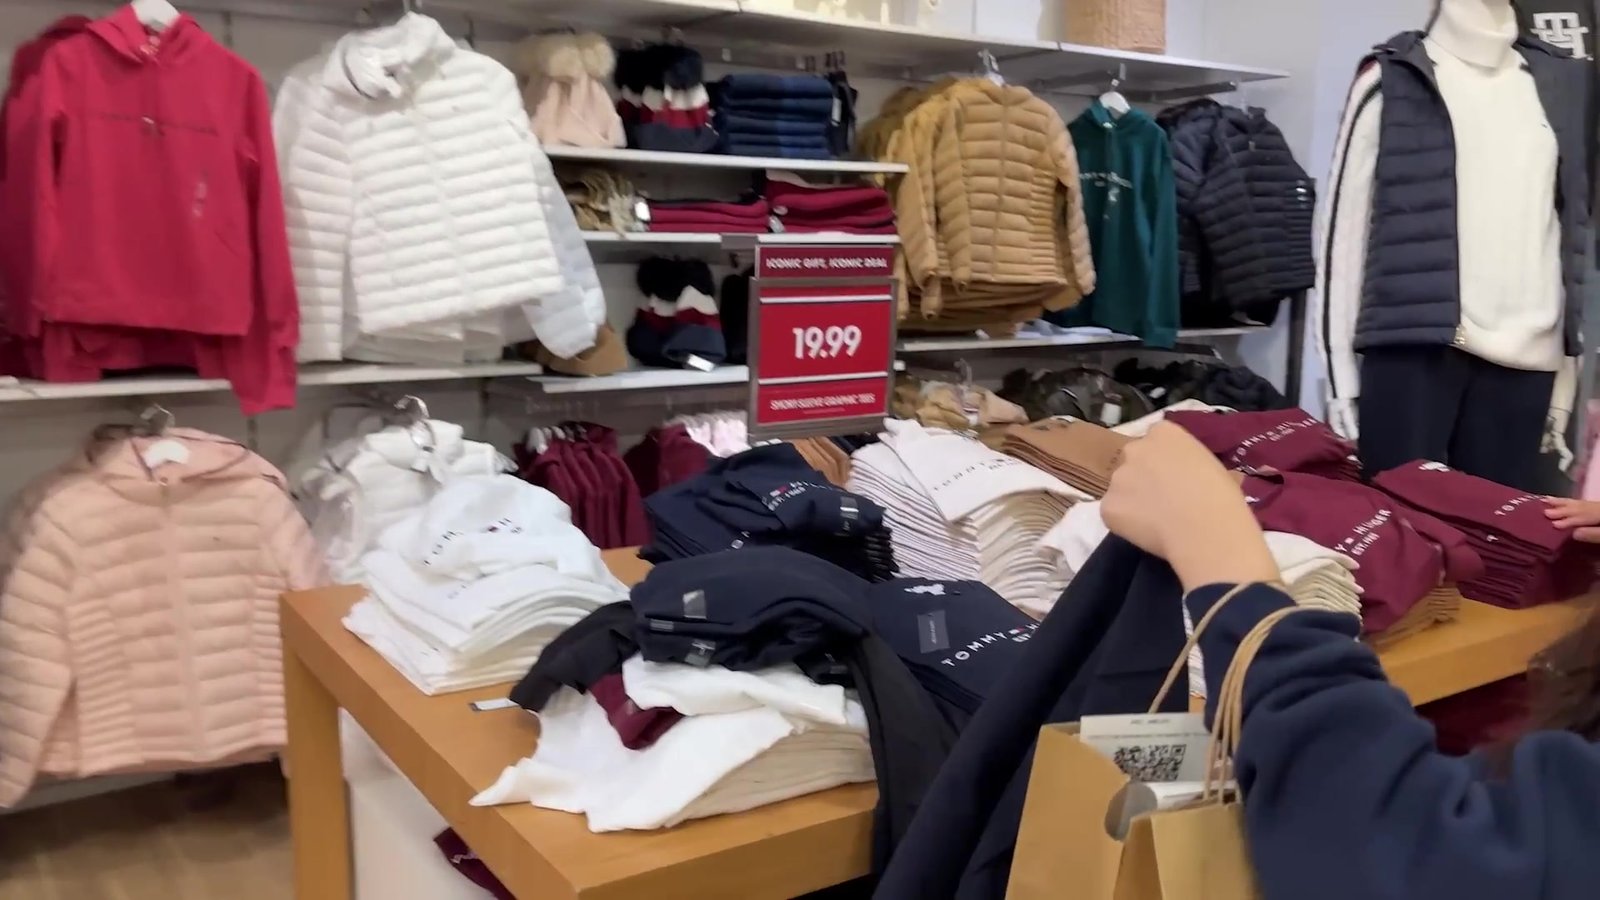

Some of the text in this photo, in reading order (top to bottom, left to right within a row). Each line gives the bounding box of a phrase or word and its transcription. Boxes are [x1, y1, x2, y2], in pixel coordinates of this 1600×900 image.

[765, 257, 801, 269] ICONIC
[829, 257, 863, 269] ICONIC
[864, 256, 888, 268] DEAL
[792, 324, 863, 360] 19.99
[940, 630, 1008, 667] TOMMY
